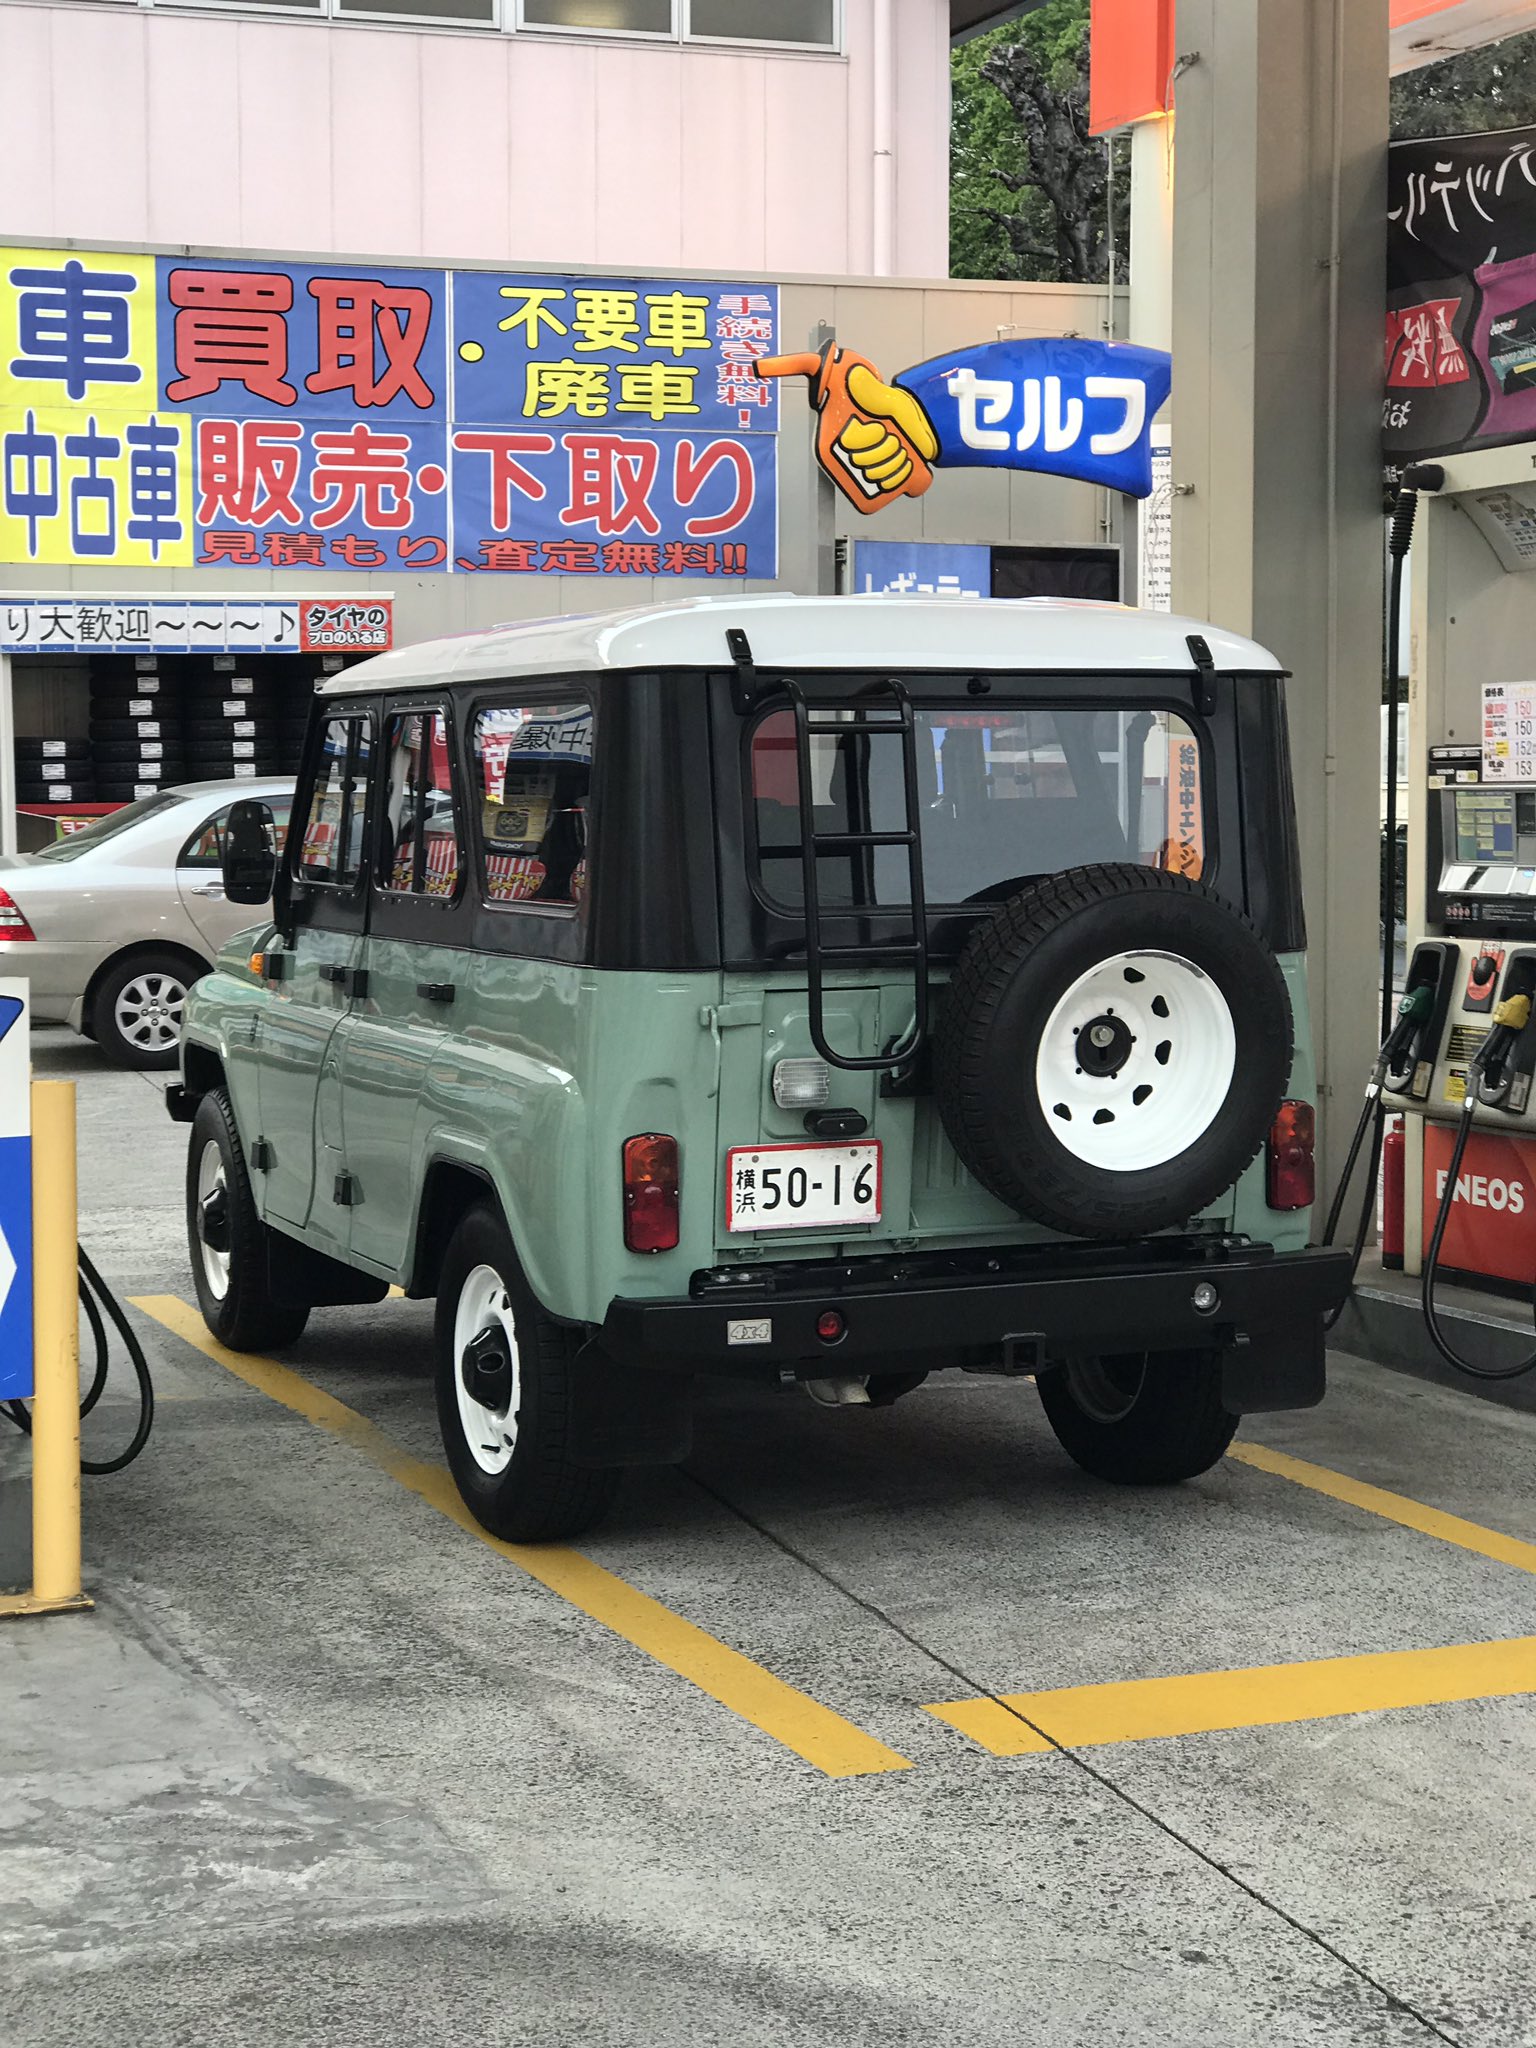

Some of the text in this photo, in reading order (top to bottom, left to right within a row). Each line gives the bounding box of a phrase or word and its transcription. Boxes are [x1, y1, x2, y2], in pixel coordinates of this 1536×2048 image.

[497, 286, 713, 358] 不要車
[522, 357, 702, 421] 廃車
[947, 368, 1147, 456] セルフ
[4, 411, 183, 561] 中古車
[307, 628, 387, 646] プロのいる店
[308, 606, 385, 628] タイヤの
[1514, 720, 1533, 736] 150
[1515, 760, 1533, 776] 153
[735, 1162, 874, 1214] 横浜 50-16
